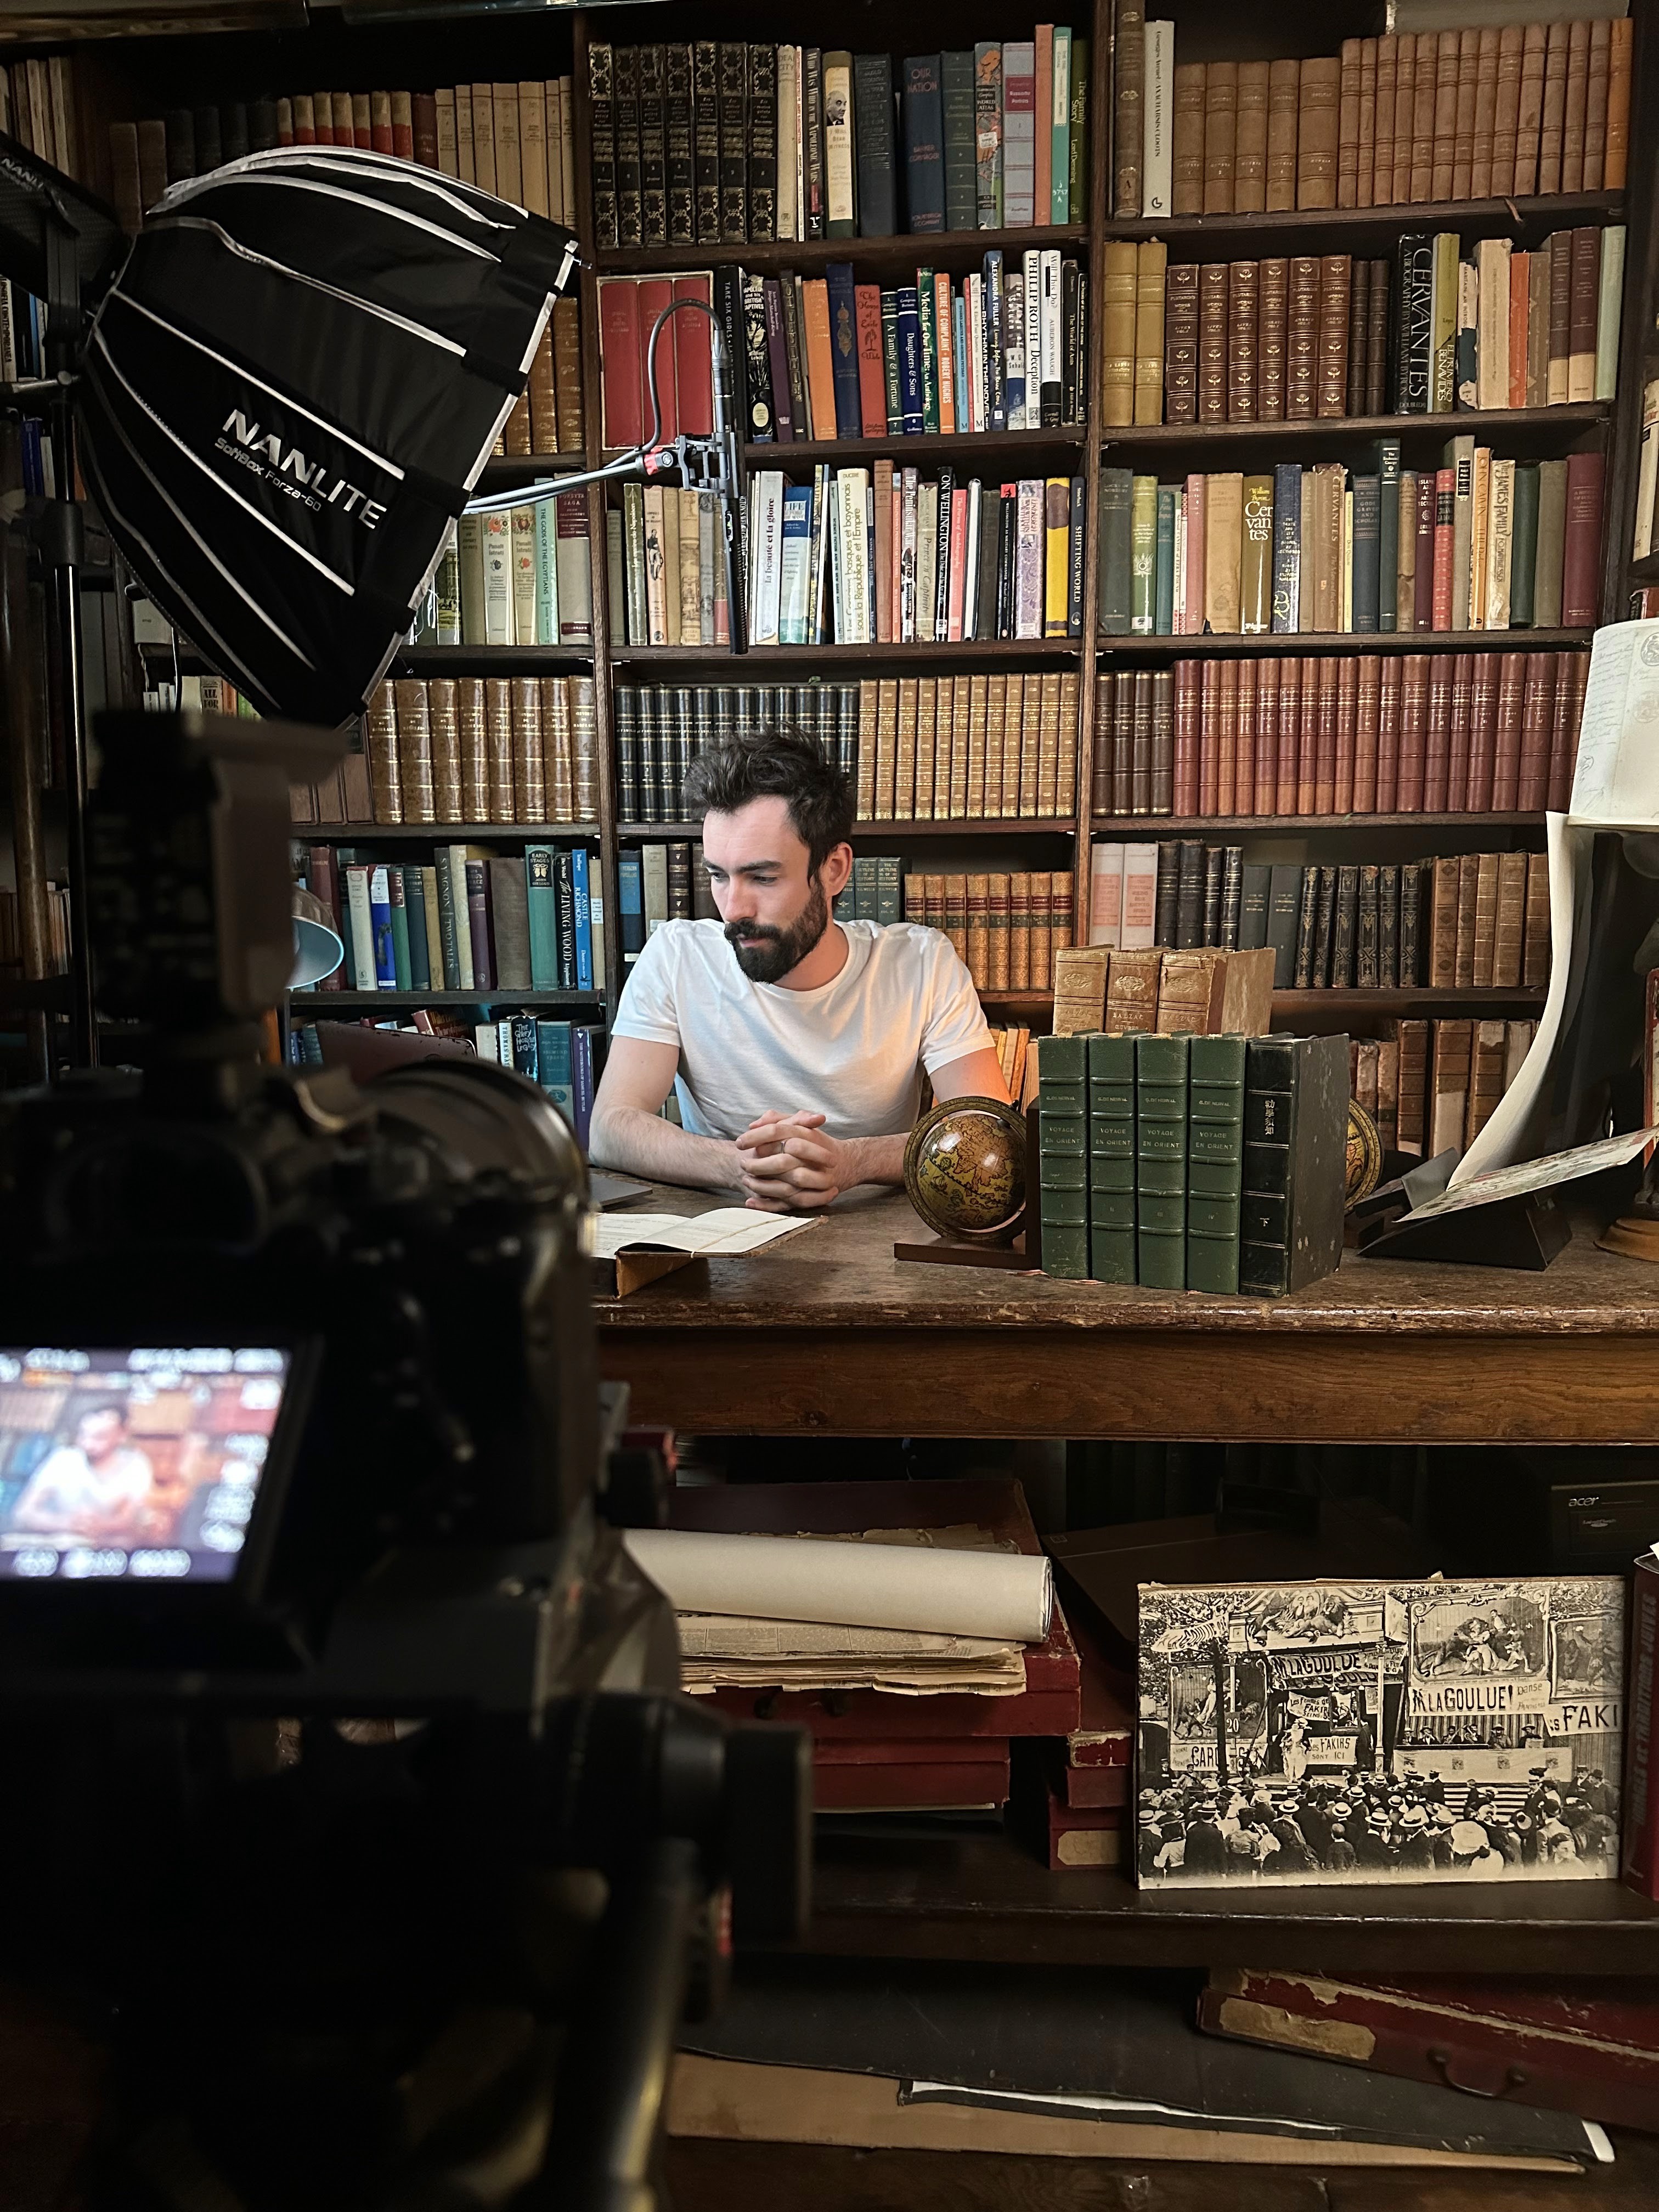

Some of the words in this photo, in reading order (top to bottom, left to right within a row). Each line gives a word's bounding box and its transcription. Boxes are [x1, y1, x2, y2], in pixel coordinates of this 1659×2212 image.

[911, 68, 930, 79] OUR
[1078, 80, 1087, 96] The
[1070, 99, 1079, 122] Story
[1076, 97, 1086, 125] Family
[724, 282, 732, 299] TAKE
[1029, 257, 1038, 302] PHILIP
[1402, 258, 1412, 309] BIOGRAPHY
[921, 291, 930, 320] Media
[939, 282, 948, 308] CULTURE
[1030, 306, 1039, 341] ROTH
[1402, 311, 1410, 321] BY
[1409, 247, 1432, 397] CERVANTES
[886, 334, 897, 360] Family
[940, 318, 950, 351] COMPLAINT
[1401, 323, 1410, 363] WILLIAM
[905, 332, 915, 369] Daughters
[1448, 344, 1455, 355] EL
[941, 357, 951, 379] ROBERT
[1027, 350, 1041, 395] Deception
[1400, 366, 1409, 396] BYRON
[1437, 349, 1447, 401] BENAVIDES
[890, 380, 899, 408] Fortune
[909, 378, 917, 396] Sons
[942, 381, 951, 404] HUGHES
[214, 436, 265, 476] SoftBox
[265, 469, 321, 512] Forza-60
[222, 408, 387, 530] NANLITE
[905, 475, 916, 489] The
[941, 475, 950, 489] ON
[1477, 456, 1488, 482] JOHN
[1477, 484, 1487, 516] CALVIN
[1497, 475, 1510, 505] JAMES
[768, 498, 776, 523] gloire
[844, 484, 854, 528] bayonnais
[905, 490, 917, 530] Peninsular
[1245, 501, 1273, 517] Cer
[1331, 476, 1341, 541] CERVANTES
[766, 524, 774, 533] la
[939, 493, 950, 551] WELLINGTON
[1245, 517, 1272, 529] van
[1249, 528, 1268, 540] tes
[1494, 505, 1511, 537] FAMILY
[855, 546, 862, 555] et
[905, 532, 915, 546] War
[923, 537, 932, 562] Prince
[765, 545, 773, 573] beauté
[845, 541, 854, 575] basques
[852, 558, 865, 603] République
[441, 875, 450, 907] AGNON
[446, 943, 454, 968] TALES
[561, 895, 571, 927] LIVING
[562, 930, 572, 961] WOOD
[516, 1024, 528, 1032] THE
[1112, 1012, 1144, 1020] BALZAC
[1259, 1217, 1269, 1227] 下
[1568, 1497, 1599, 1506] acer
[1444, 1685, 1513, 1712] GOULUE!
[1226, 1718, 1239, 1733] 20
[1320, 1737, 1350, 1750] FAKIRS
[1334, 1752, 1345, 1760] ICI
